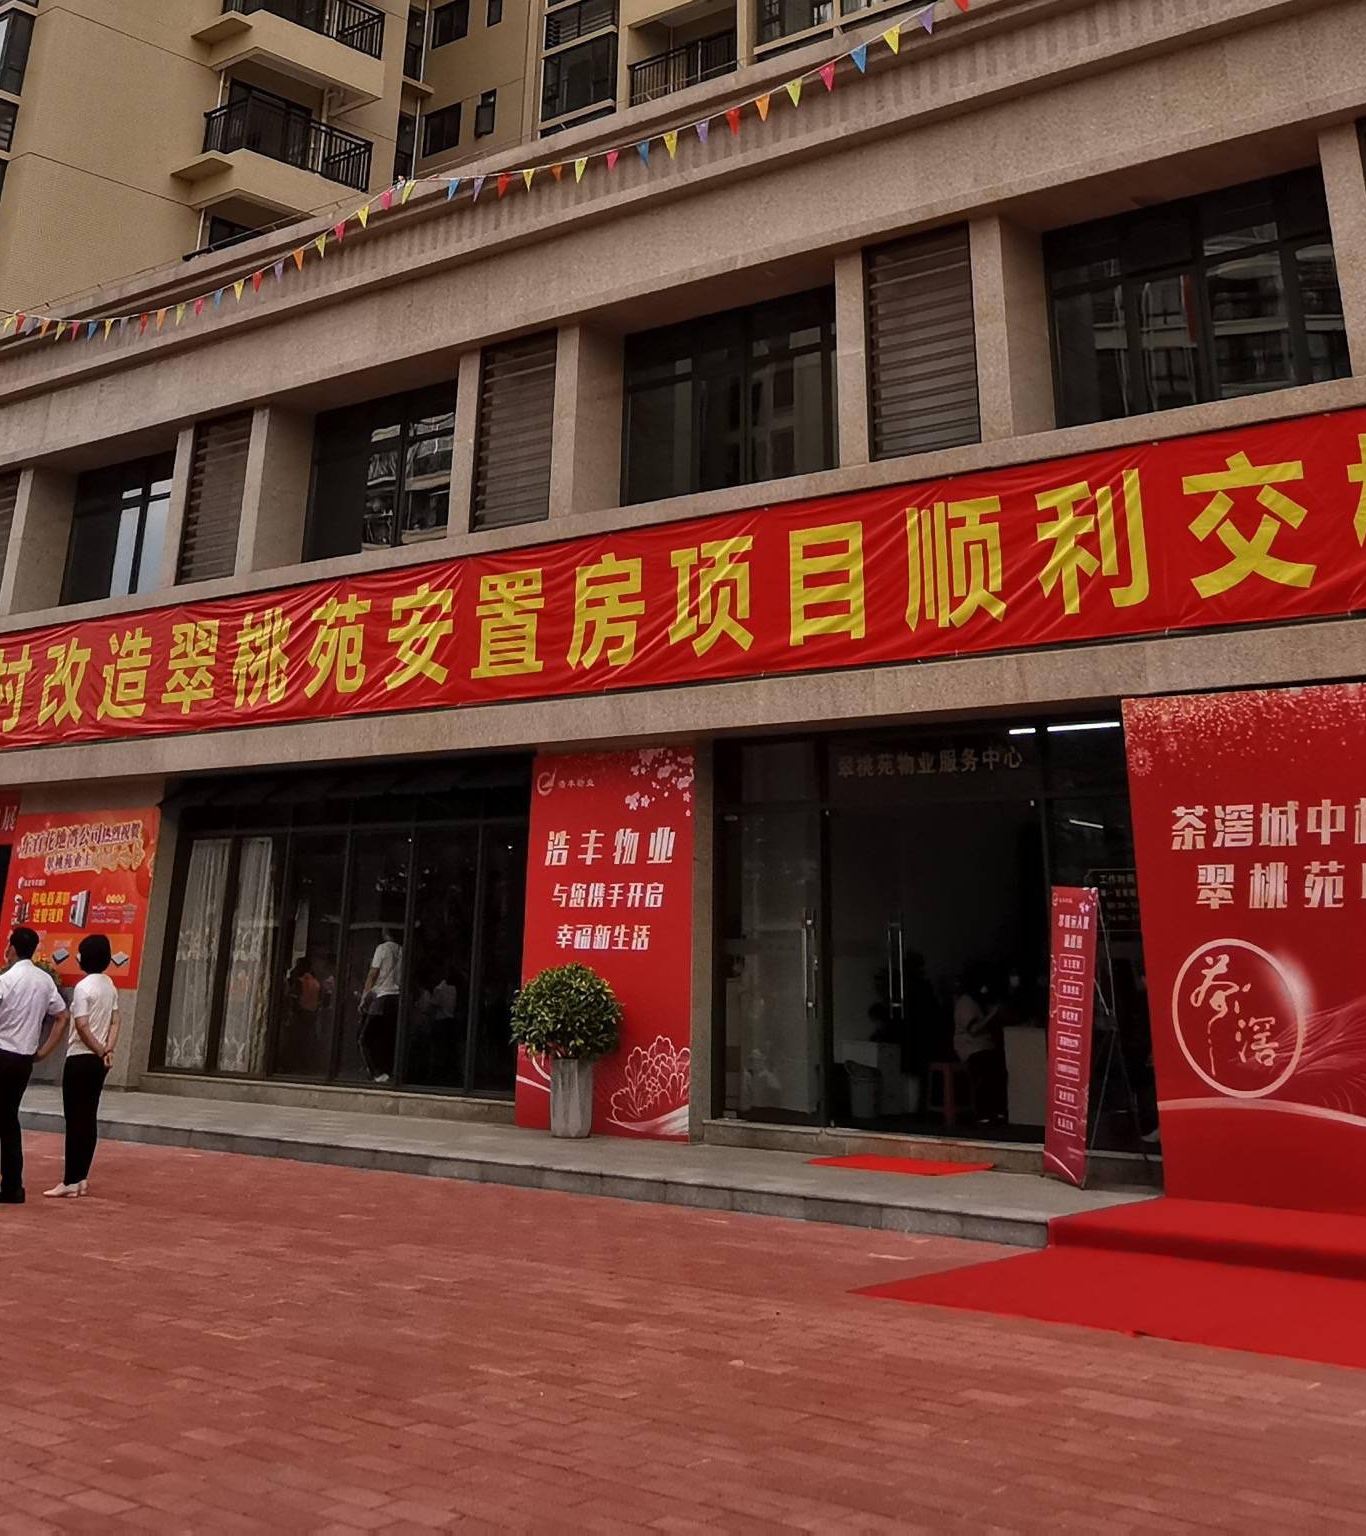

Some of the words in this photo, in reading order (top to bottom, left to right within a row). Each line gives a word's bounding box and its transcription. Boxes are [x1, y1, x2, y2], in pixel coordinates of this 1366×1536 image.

[544, 827, 676, 866] 浩丰物业
[552, 882, 664, 908] 与您携手开启
[556, 924, 651, 950] 幸福新生活
